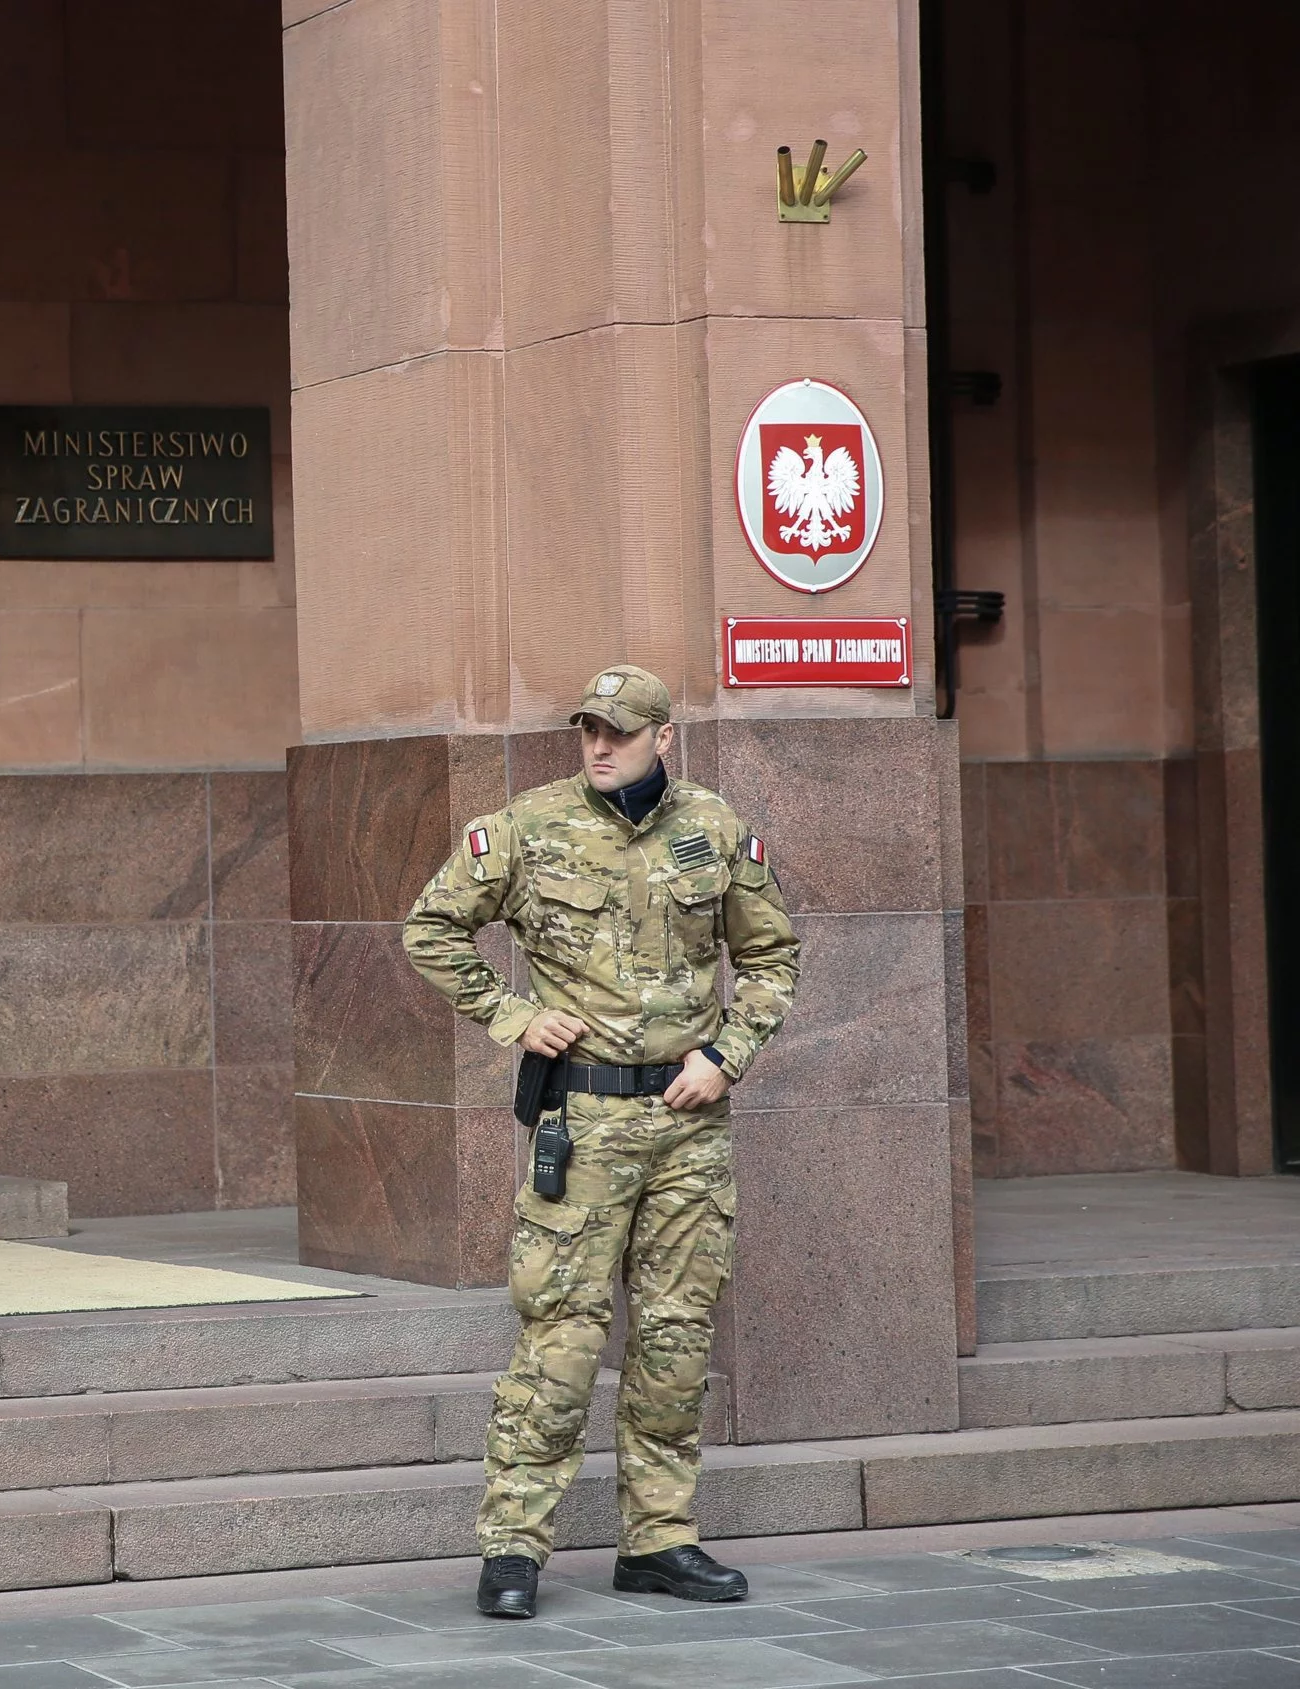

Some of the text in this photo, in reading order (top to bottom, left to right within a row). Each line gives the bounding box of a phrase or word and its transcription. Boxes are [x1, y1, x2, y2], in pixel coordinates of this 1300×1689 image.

[23, 431, 248, 458] MINISTERSTWO
[87, 464, 184, 491] SPRAW
[14, 497, 254, 524] ZAGRANICZNYCH
[735, 639, 902, 664] MINISTERSTWO SPRAW ZAGRANICZNYCH
